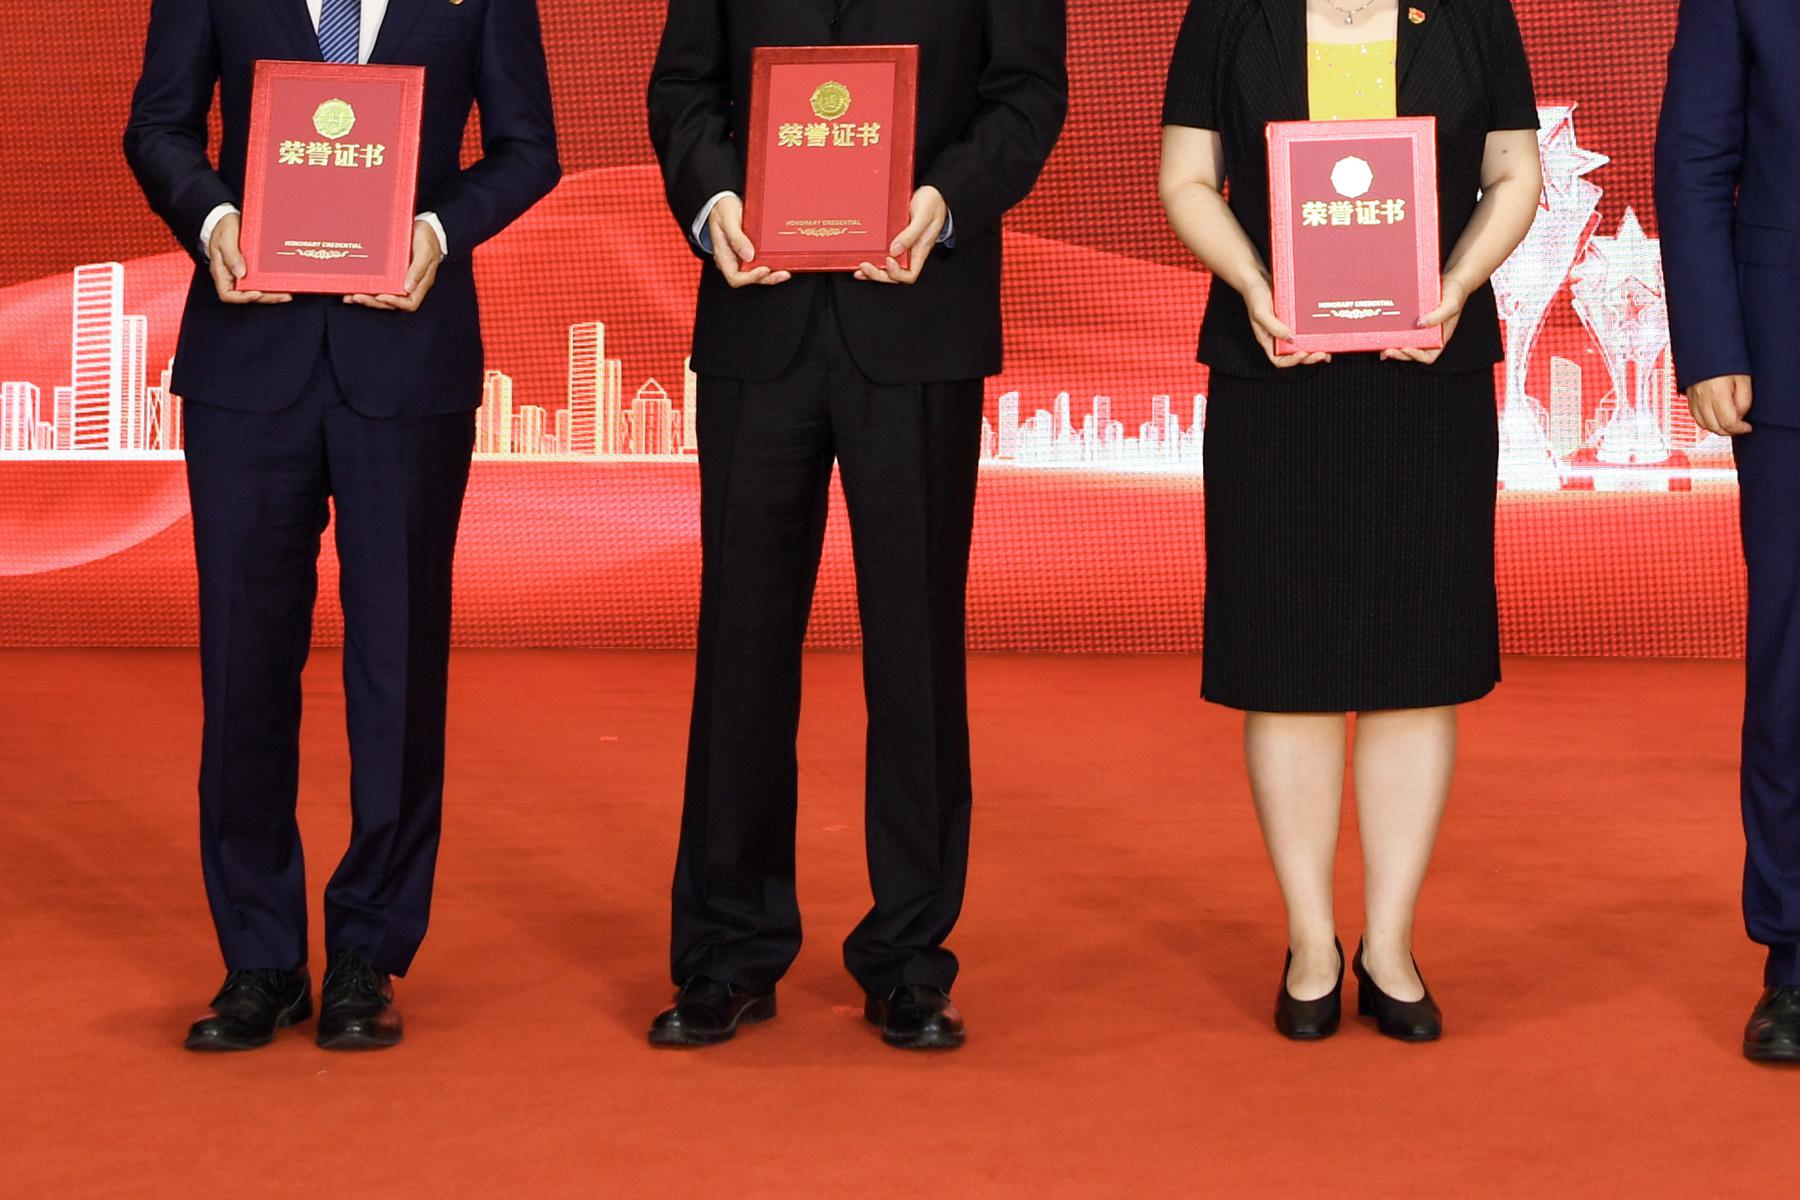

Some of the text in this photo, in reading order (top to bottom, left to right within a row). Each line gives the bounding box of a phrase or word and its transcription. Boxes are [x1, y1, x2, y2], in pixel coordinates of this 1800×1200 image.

[778, 122, 881, 147] 荣誉证书
[278, 140, 385, 168] 荣誉证书
[1302, 199, 1405, 226] 荣誉证书
